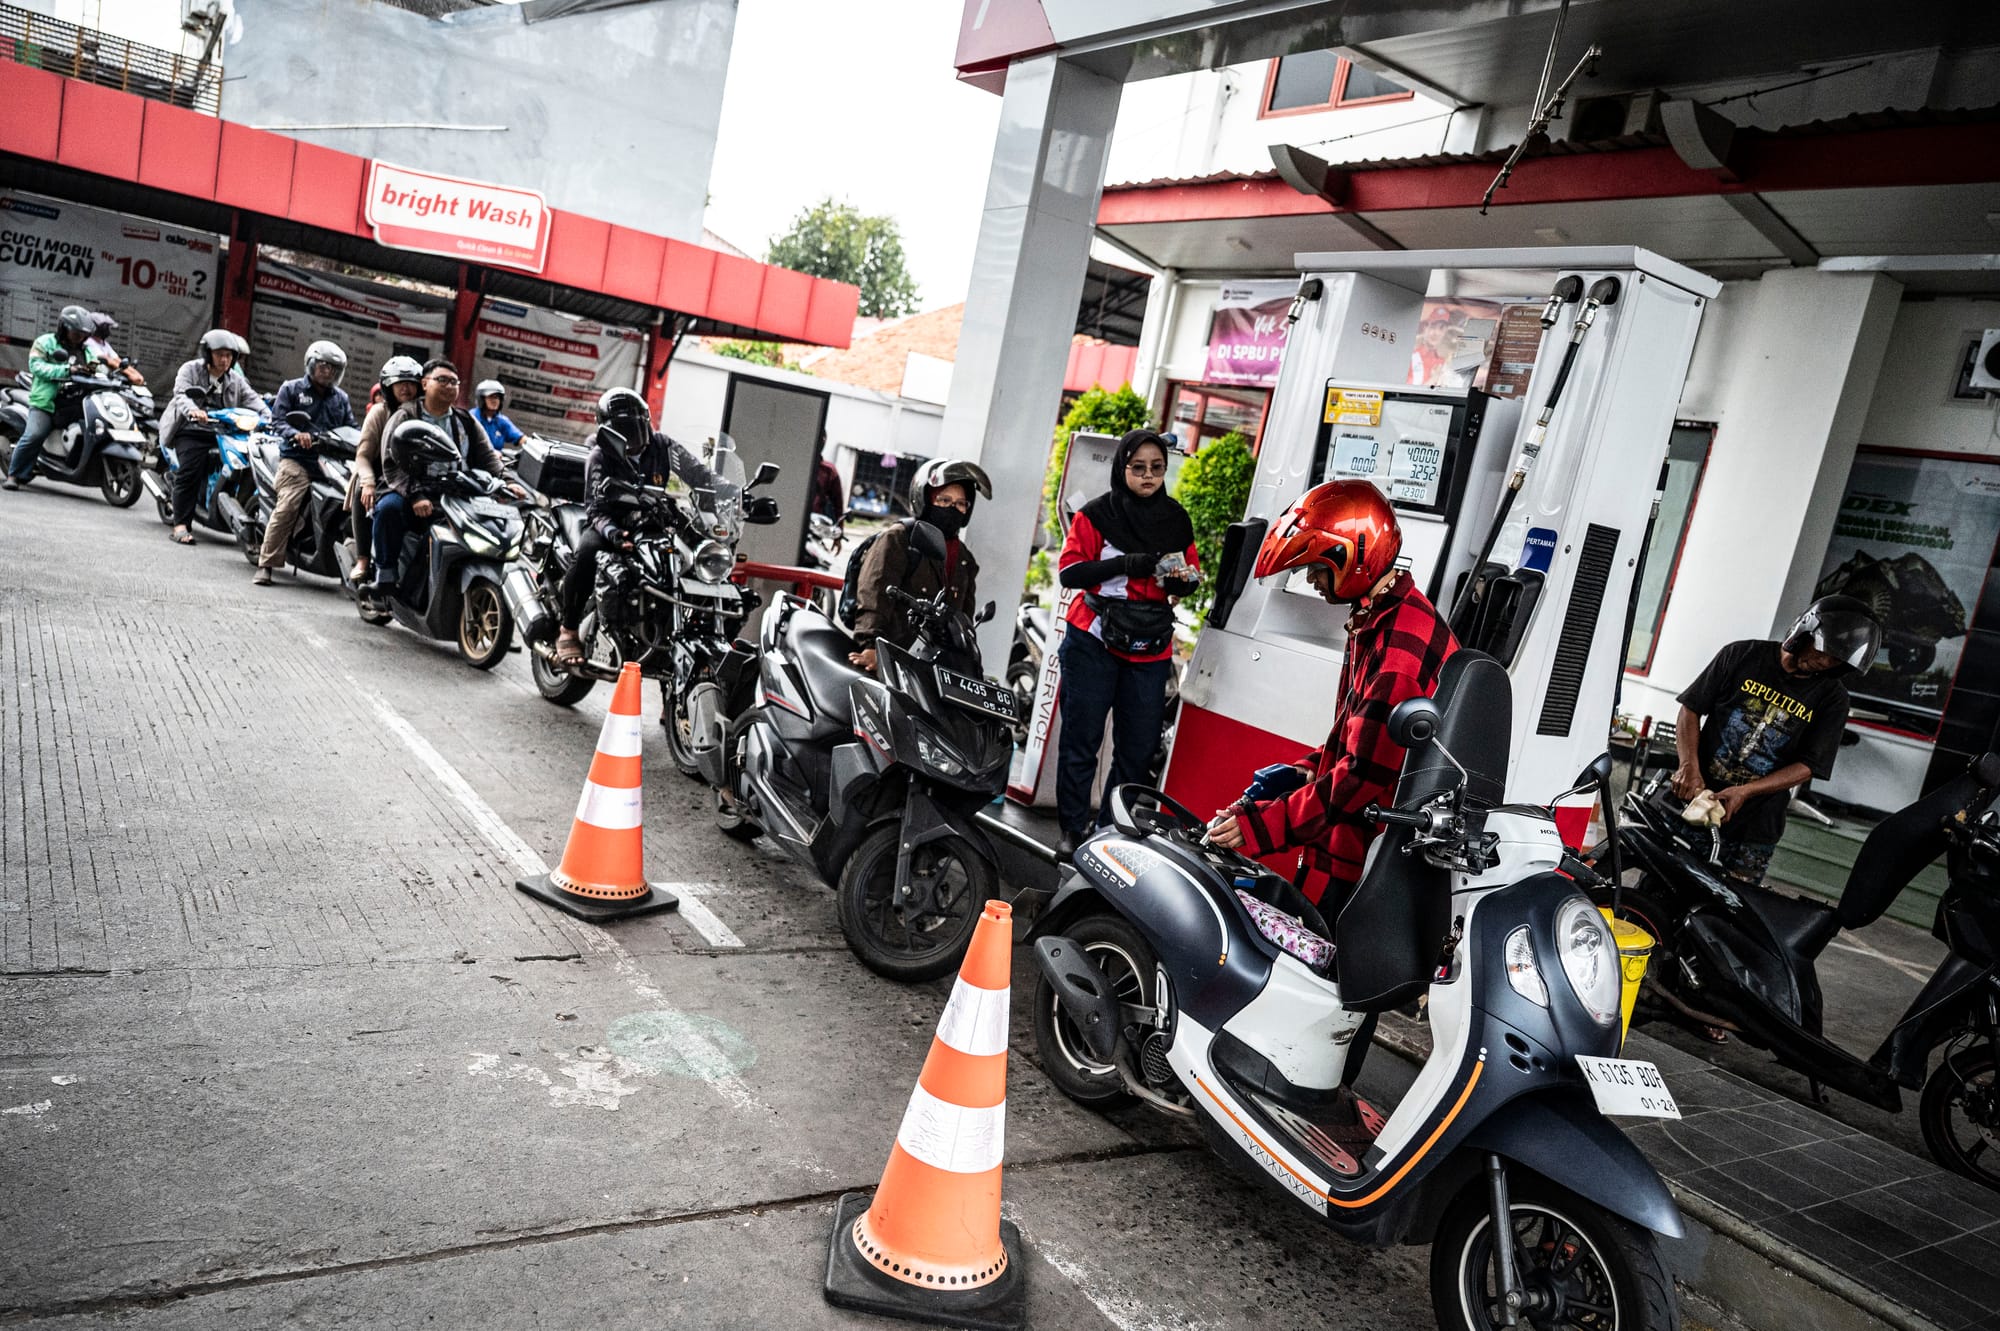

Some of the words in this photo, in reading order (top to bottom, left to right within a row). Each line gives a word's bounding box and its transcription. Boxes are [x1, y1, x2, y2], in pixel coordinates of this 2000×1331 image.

[381, 183, 459, 216] bright
[467, 198, 533, 229] Wash
[1, 230, 41, 248] CUCI
[44, 239, 95, 260] MOBIL
[0, 245, 94, 279] CUMAN
[101, 251, 115, 262] Rp
[116, 256, 156, 289] 10
[158, 270, 188, 287] ribu
[260, 275, 298, 293] DAFTAR
[485, 323, 520, 340] DAFTAR
[549, 337, 566, 350] CAR
[567, 342, 593, 355] WASH
[1217, 344, 1232, 360] DI
[1233, 344, 1268, 361] SPBU
[1371, 442, 1379, 457] 0
[1407, 447, 1440, 464] 40000
[1525, 516, 1530, 524] 1
[1526, 537, 1556, 548] PERTAMAX
[943, 672, 952, 685] H
[960, 679, 987, 697] 4435
[1032, 653, 1060, 749] SERVICE
[1741, 679, 1814, 723] SEPULTURA
[1082, 853, 1127, 889] SCOOPY
[1598, 1062, 1635, 1086] 6135
